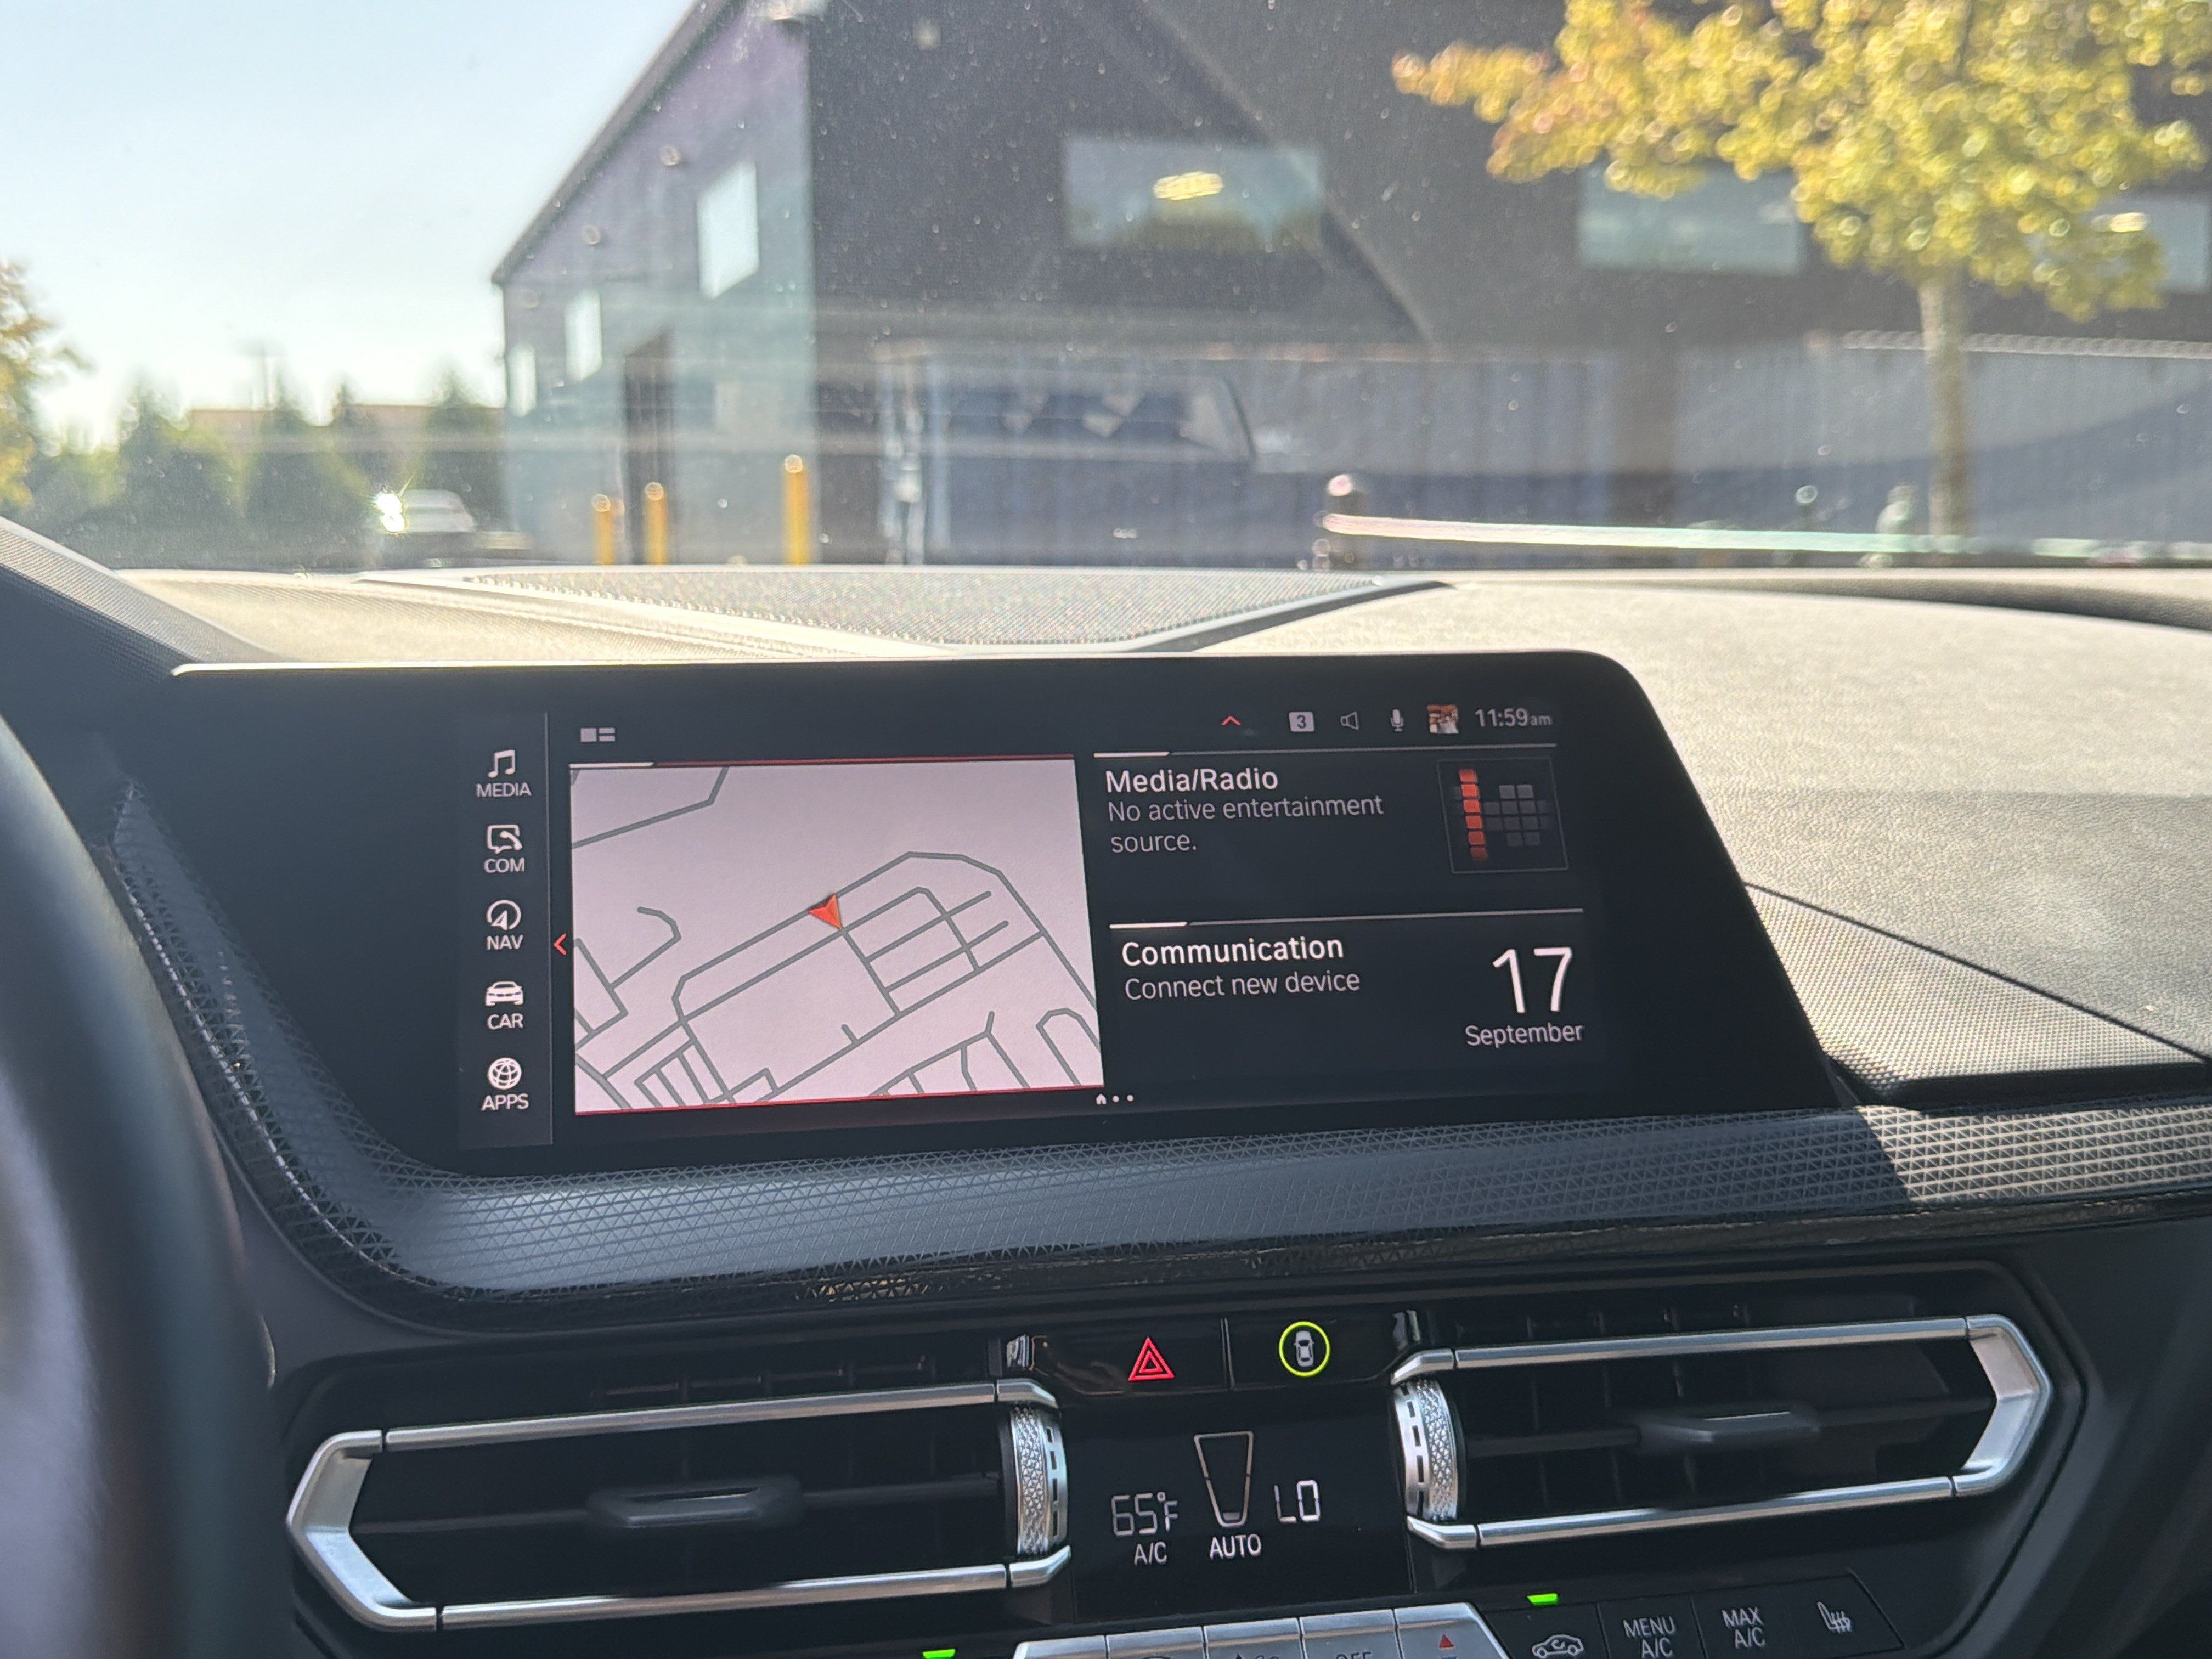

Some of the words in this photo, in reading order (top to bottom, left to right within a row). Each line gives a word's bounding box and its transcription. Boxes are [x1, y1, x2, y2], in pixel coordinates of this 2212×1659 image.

[1295, 714, 1307, 729] 3
[1475, 707, 1553, 727] 11:59am
[476, 782, 532, 798] MEDIA
[1105, 767, 1279, 793] Media/Radio
[1108, 800, 1141, 822] No
[1148, 798, 1216, 822] active
[1223, 795, 1384, 819] entertainment
[1110, 834, 1198, 853] source.
[484, 857, 526, 873] COM
[487, 934, 523, 951] NAV
[1121, 936, 1344, 967] Communication
[1125, 975, 1226, 1001] Connect
[1232, 977, 1278, 996] new
[1285, 969, 1361, 994] device
[1492, 946, 1573, 1014] 17
[487, 1013, 524, 1030] CAR
[1465, 1022, 1584, 1049] September
[481, 1093, 529, 1111] APPS
[1111, 1492, 1178, 1536] 65°F
[1134, 1541, 1168, 1565] A/C
[1209, 1534, 1262, 1559] AUTO
[1623, 1616, 1676, 1638] MENU
[1721, 1607, 1763, 1628] MAX
[1641, 1637, 1673, 1659] A/C
[1734, 1627, 1766, 1649] A/C
